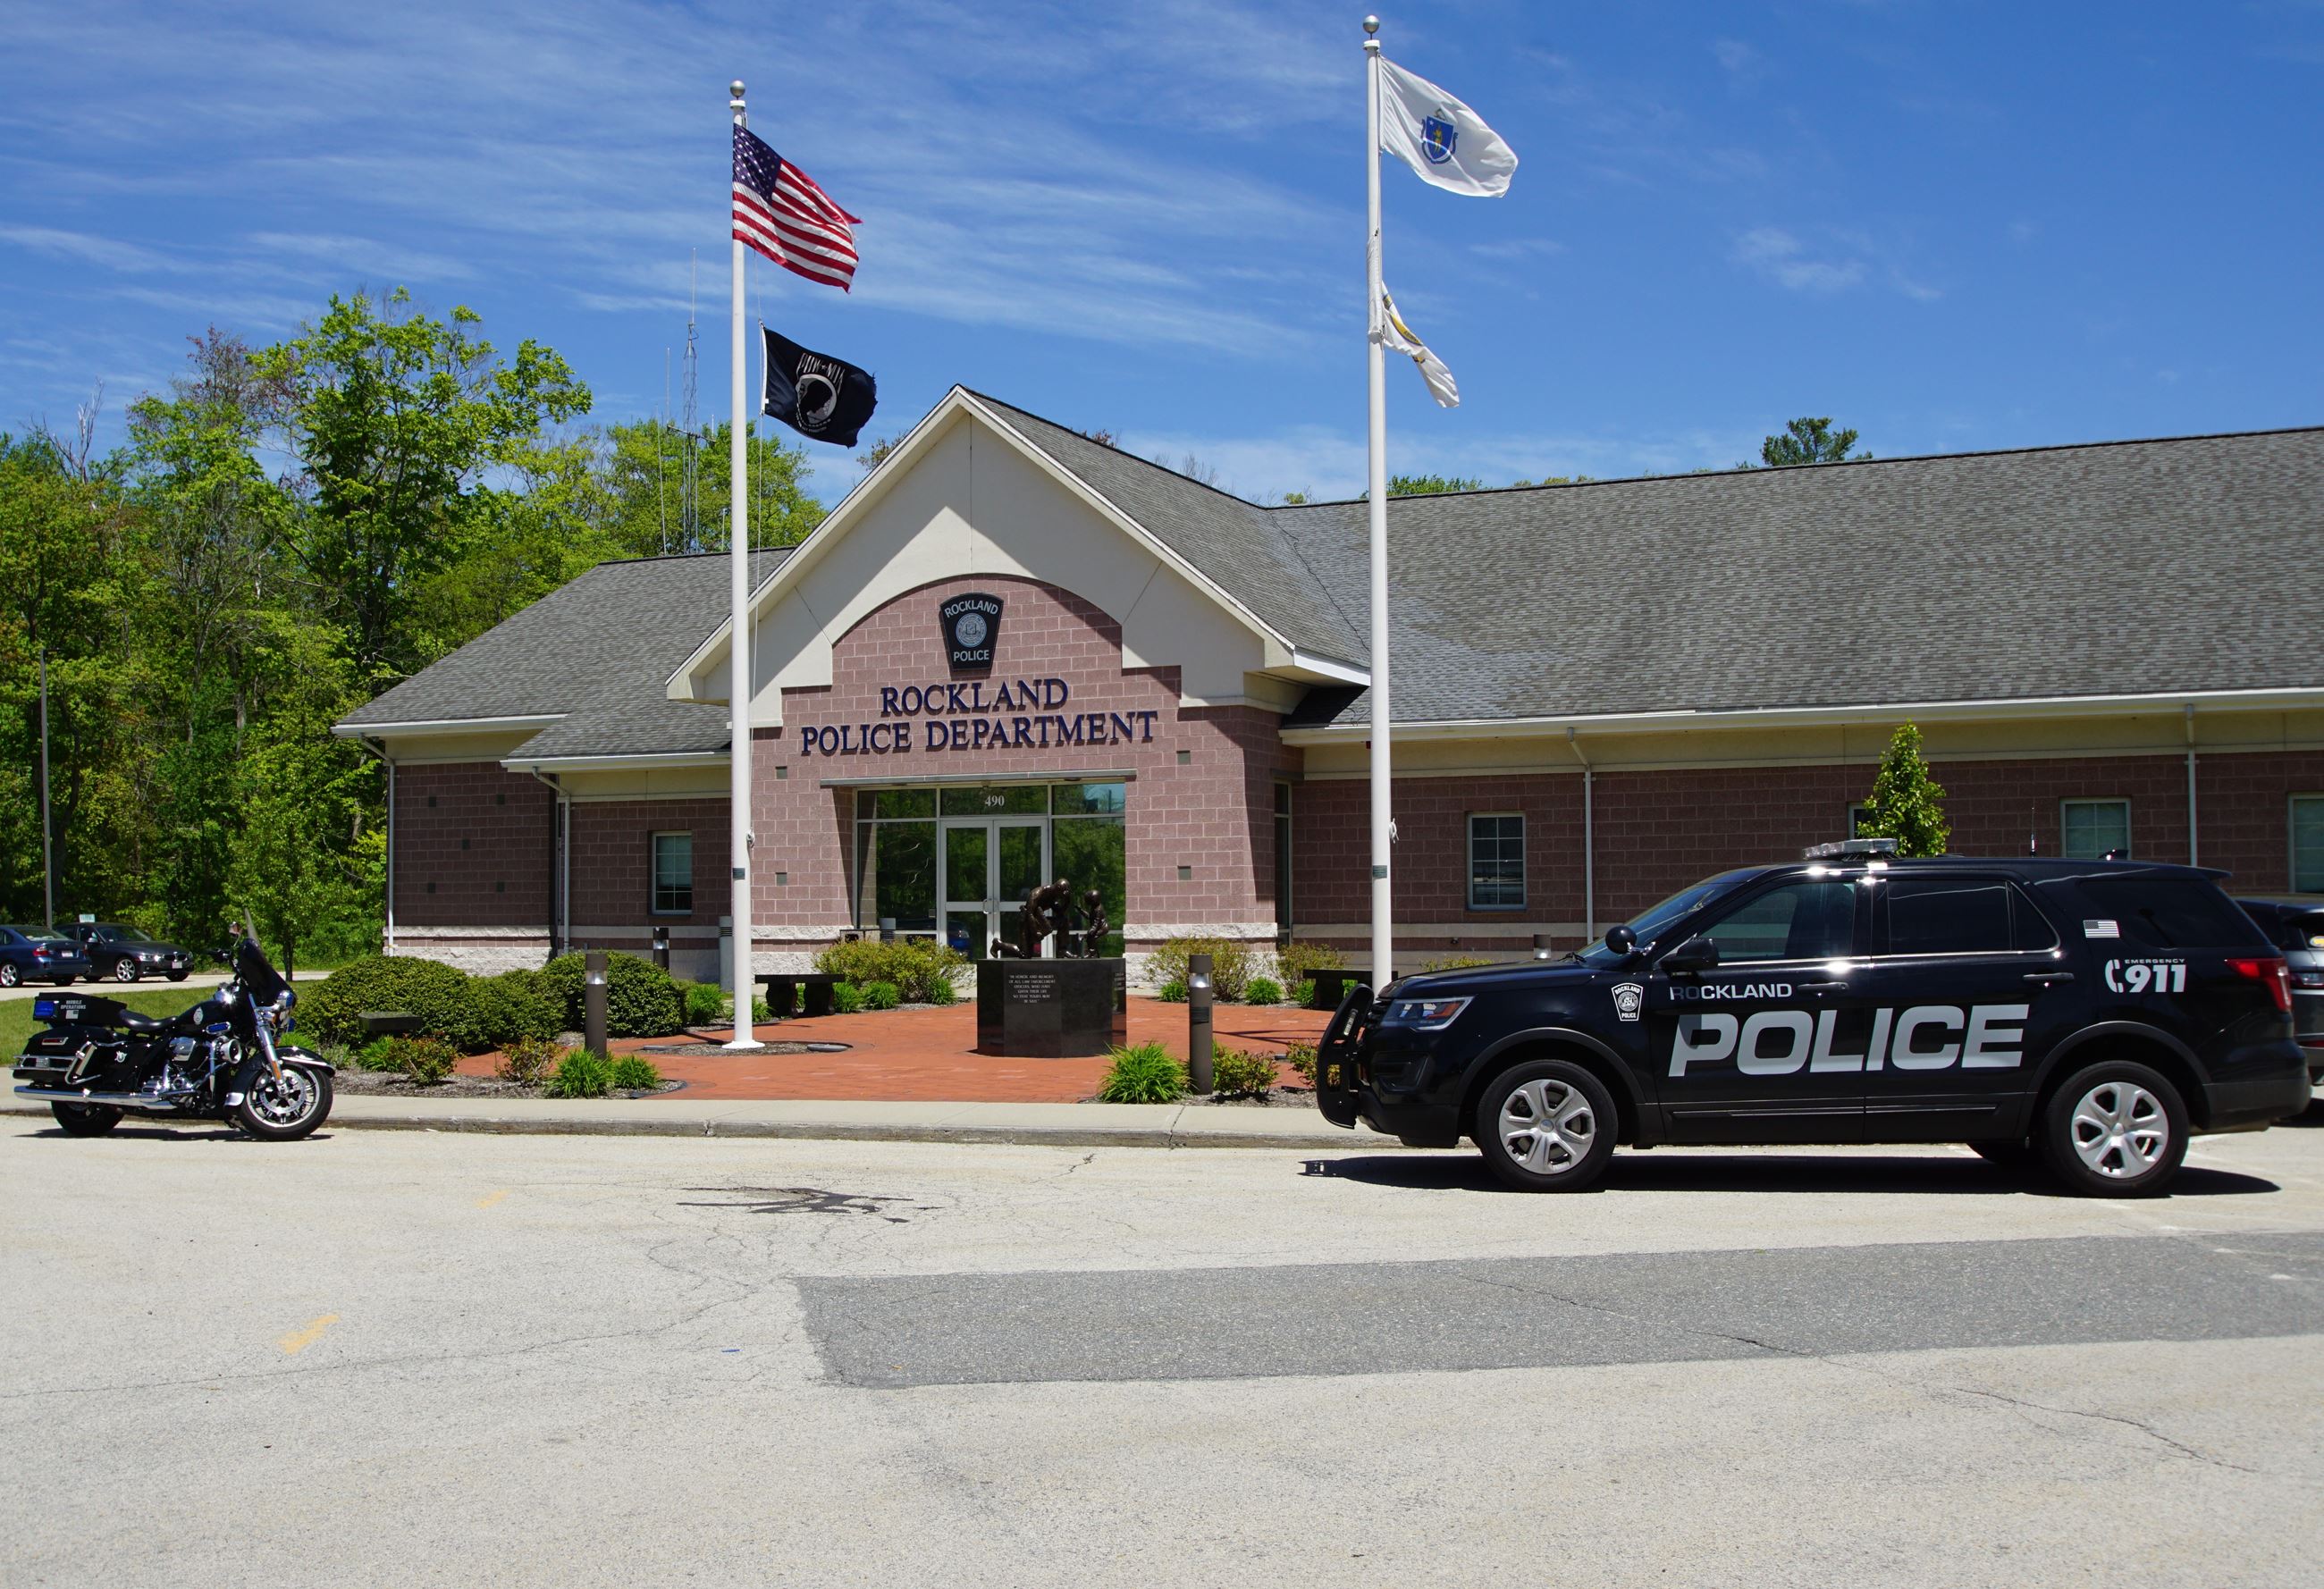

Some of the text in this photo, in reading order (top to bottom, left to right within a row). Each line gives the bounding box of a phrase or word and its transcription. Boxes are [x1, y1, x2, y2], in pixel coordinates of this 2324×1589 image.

[944, 600, 998, 618] ROCKLAND
[953, 649, 989, 662] POLICE
[880, 677, 1068, 716] ROCKLAND
[802, 711, 1158, 755] POLICE DEPARTMENT
[984, 794, 1005, 807] 490
[2124, 964, 2186, 993] 911
[1614, 985, 1640, 995] ROCKLAND
[1670, 983, 1792, 1001] ROCKLAND
[1668, 1004, 2030, 1078] POLICE
